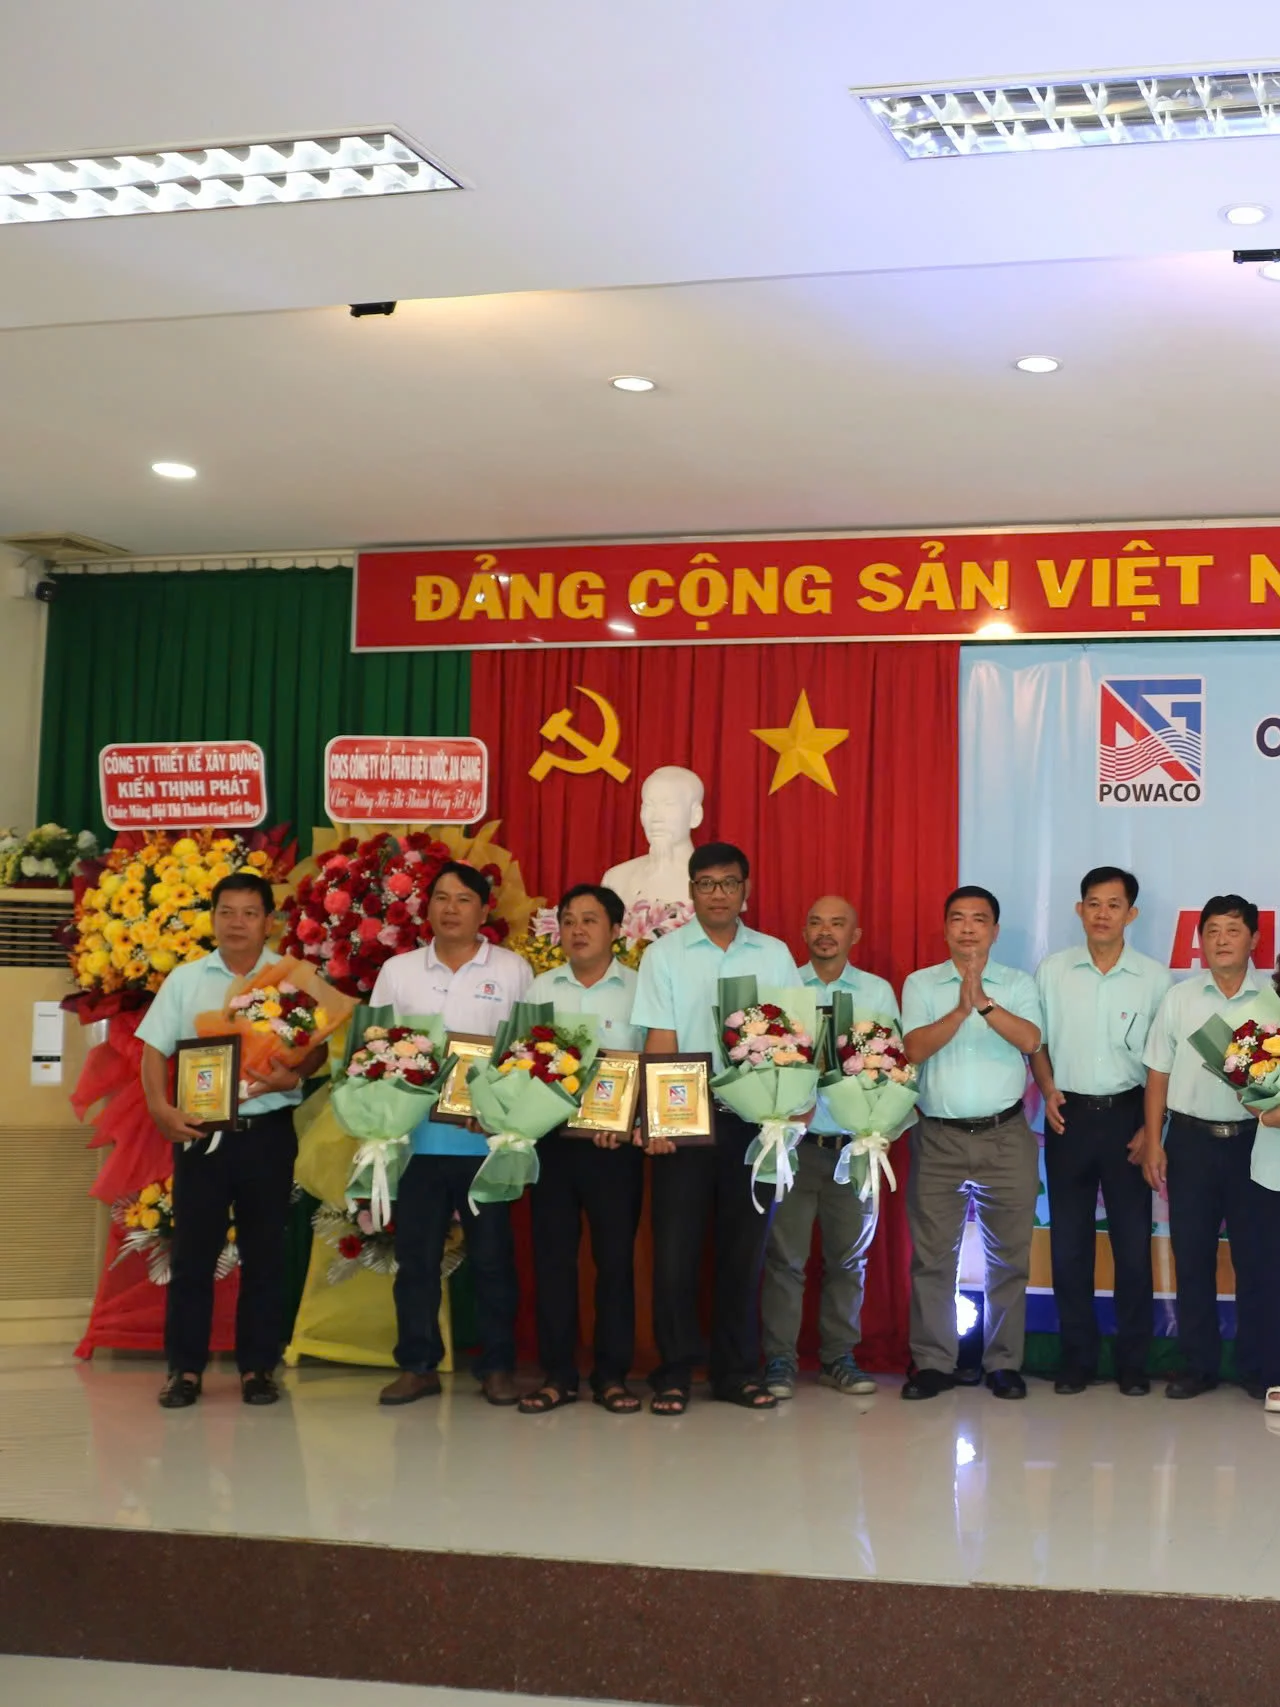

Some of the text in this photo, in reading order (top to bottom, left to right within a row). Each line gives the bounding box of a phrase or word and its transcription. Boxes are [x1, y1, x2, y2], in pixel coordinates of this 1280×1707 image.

[412, 553, 606, 622] ĐẢNG
[627, 552, 832, 631] CỘNG
[858, 541, 1009, 612] SẢN
[1036, 540, 1215, 622] VIỆT
[136, 756, 151, 774] TY
[118, 775, 250, 800] KIẾN THỊNH PHÁT
[1099, 783, 1201, 802] POWACO
